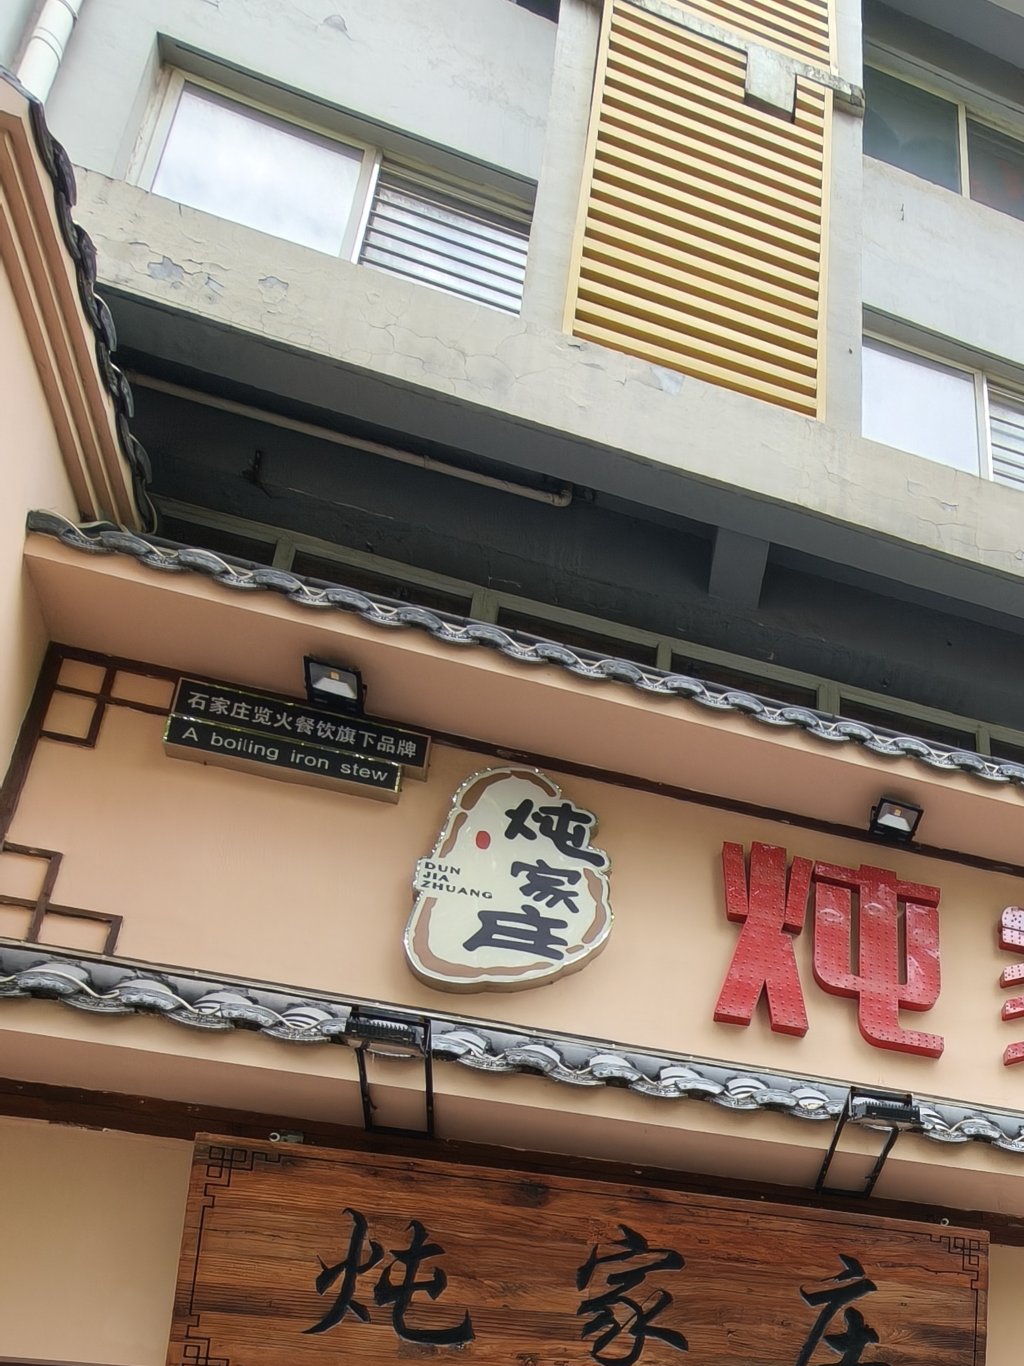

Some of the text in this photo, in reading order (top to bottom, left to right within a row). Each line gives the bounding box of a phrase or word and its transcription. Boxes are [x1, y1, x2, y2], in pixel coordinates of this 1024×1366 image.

[187, 691, 417, 758] 石家庄览火餐饮旗下品牌
[182, 727, 389, 782] A boiling iron stew
[423, 871, 450, 883] JIA
[424, 861, 461, 875] DUN
[463, 798, 606, 961] 炖家庄
[420, 880, 493, 899] ZHUANG
